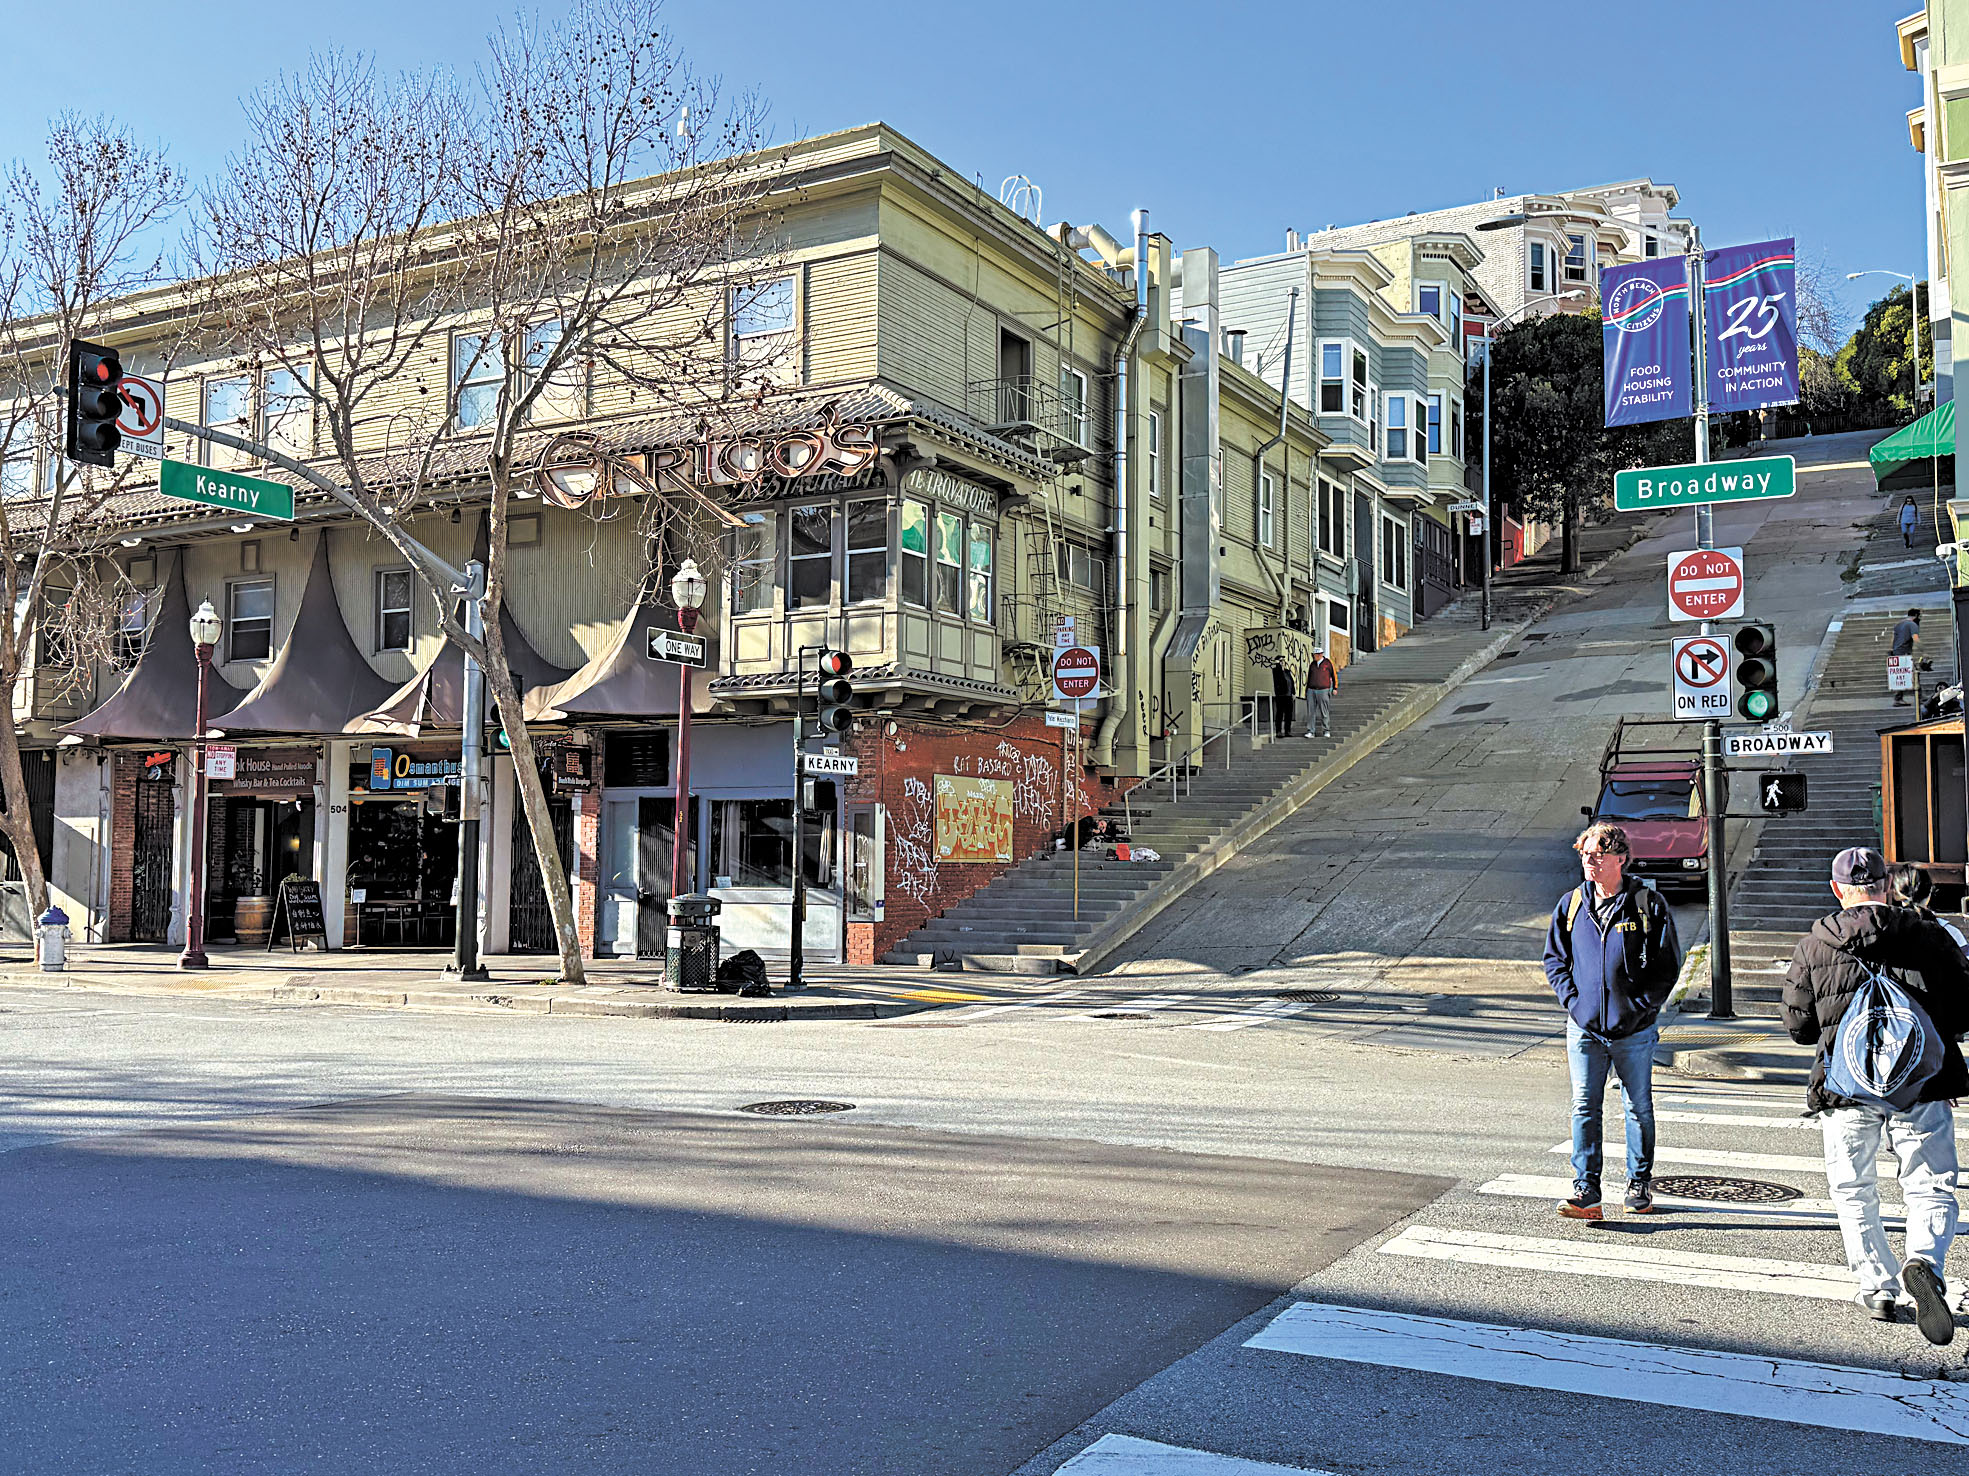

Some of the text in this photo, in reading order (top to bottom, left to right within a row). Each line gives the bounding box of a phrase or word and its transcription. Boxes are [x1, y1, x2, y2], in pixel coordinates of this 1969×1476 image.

[1613, 282, 1656, 314] NORTH BEACH
[1626, 307, 1660, 330] CITIZENS
[1717, 292, 1787, 341] 25
[1736, 342, 1768, 359] years
[1630, 365, 1661, 377] FOOD
[1717, 361, 1787, 378] COMMUNITY
[1623, 377, 1672, 391] HOUSING
[1725, 377, 1783, 393] IN ACTION
[1621, 390, 1674, 406] STABILITY
[136, 442, 158, 456] BUSES
[196, 474, 260, 508] Kearny
[926, 470, 993, 513] TROVATORE
[1637, 471, 1772, 500] Broadway
[1680, 563, 1731, 577] DO NOT
[1685, 592, 1726, 606] ENTER
[1057, 617, 1065, 625] NO
[665, 640, 700, 657] ONE WAY
[1060, 656, 1093, 667] DO NOT
[1888, 656, 1899, 667] NO
[1889, 666, 1911, 675] PARKING
[1063, 679, 1090, 689] ENTER
[1678, 694, 1728, 709] ON RED
[1773, 724, 1789, 732] 500
[1730, 735, 1827, 752] BROADWAY
[246, 757, 271, 772] House
[395, 754, 463, 778] Osmanthus
[808, 757, 855, 771] KEARNY
[977, 756, 1013, 777] BASTARD
[233, 776, 306, 790] Whisky Bar & Tea Cocktails
[396, 779, 410, 788] DIM
[413, 779, 429, 788] SUM
[330, 805, 347, 814] 504
[1615, 921, 1637, 933] TTB
